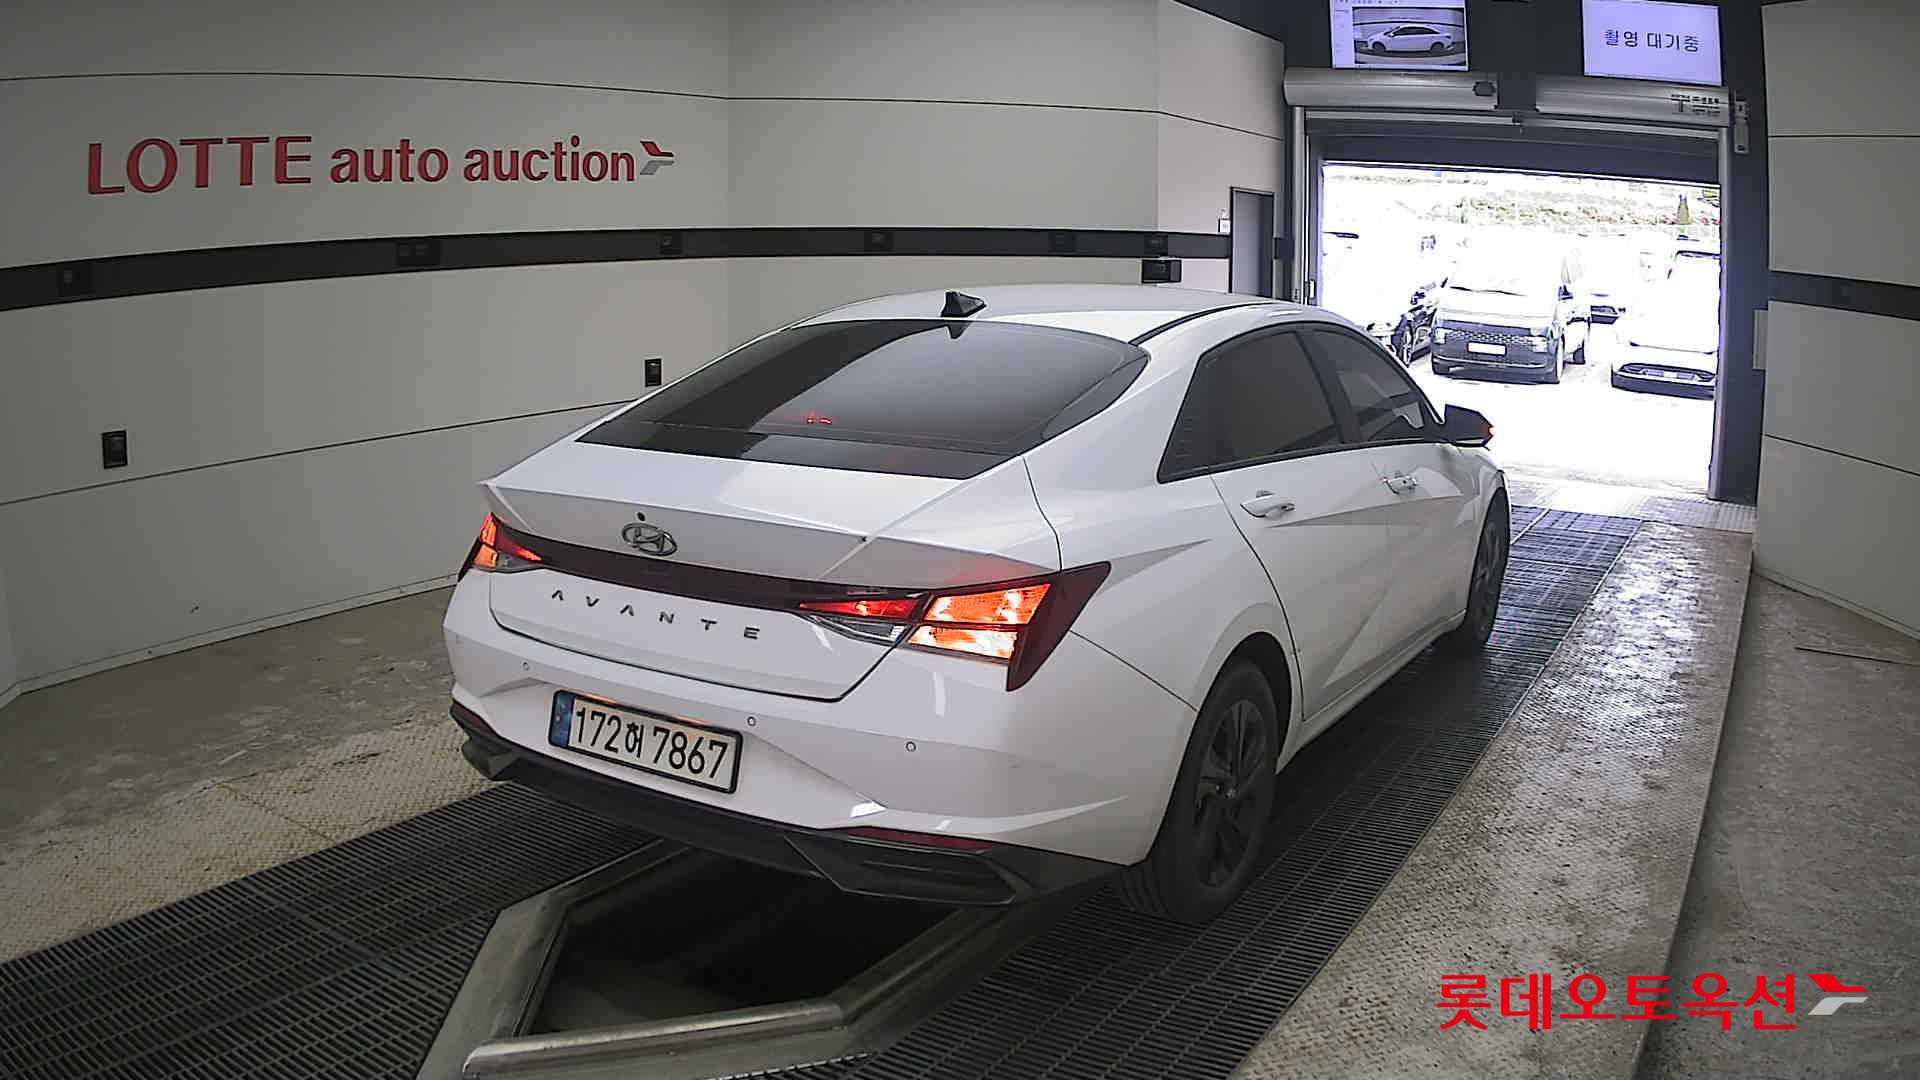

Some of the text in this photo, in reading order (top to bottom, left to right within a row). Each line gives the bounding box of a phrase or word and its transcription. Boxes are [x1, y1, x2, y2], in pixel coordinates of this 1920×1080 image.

[1646, 32, 1699, 53] 대기중
[87, 135, 635, 195] LOTTE auto auction
[551, 589, 761, 640] AVANTE
[575, 707, 729, 779] 172허 7867
